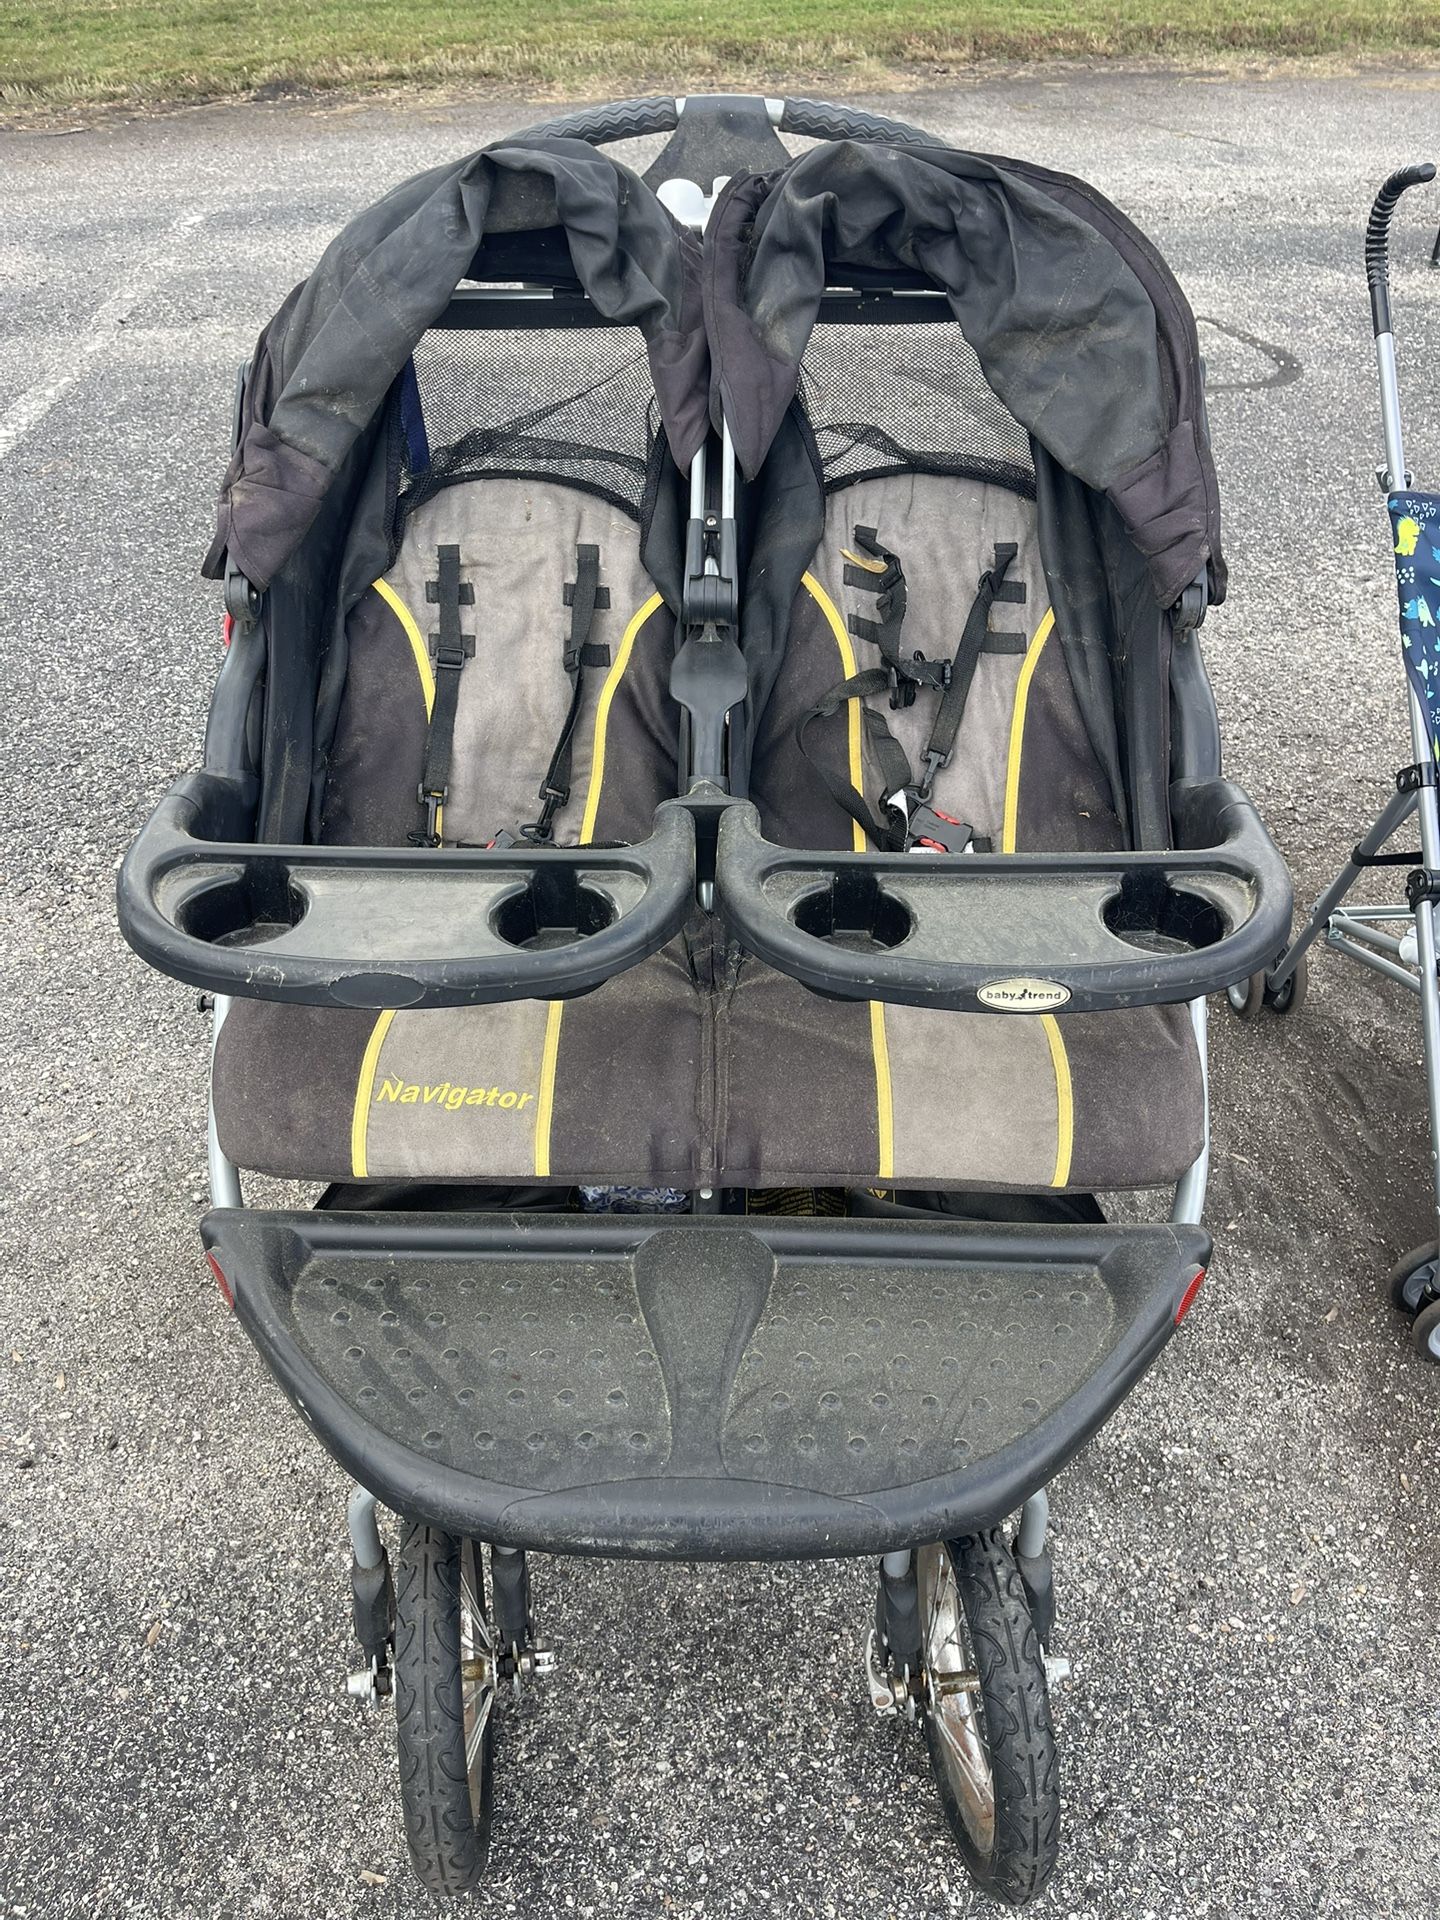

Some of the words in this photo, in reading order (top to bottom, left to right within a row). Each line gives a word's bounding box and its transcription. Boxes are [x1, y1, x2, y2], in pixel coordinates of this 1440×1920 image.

[986, 990, 1016, 1001] baby
[1028, 990, 1061, 1000] trend
[376, 1079, 534, 1110] Navigator
